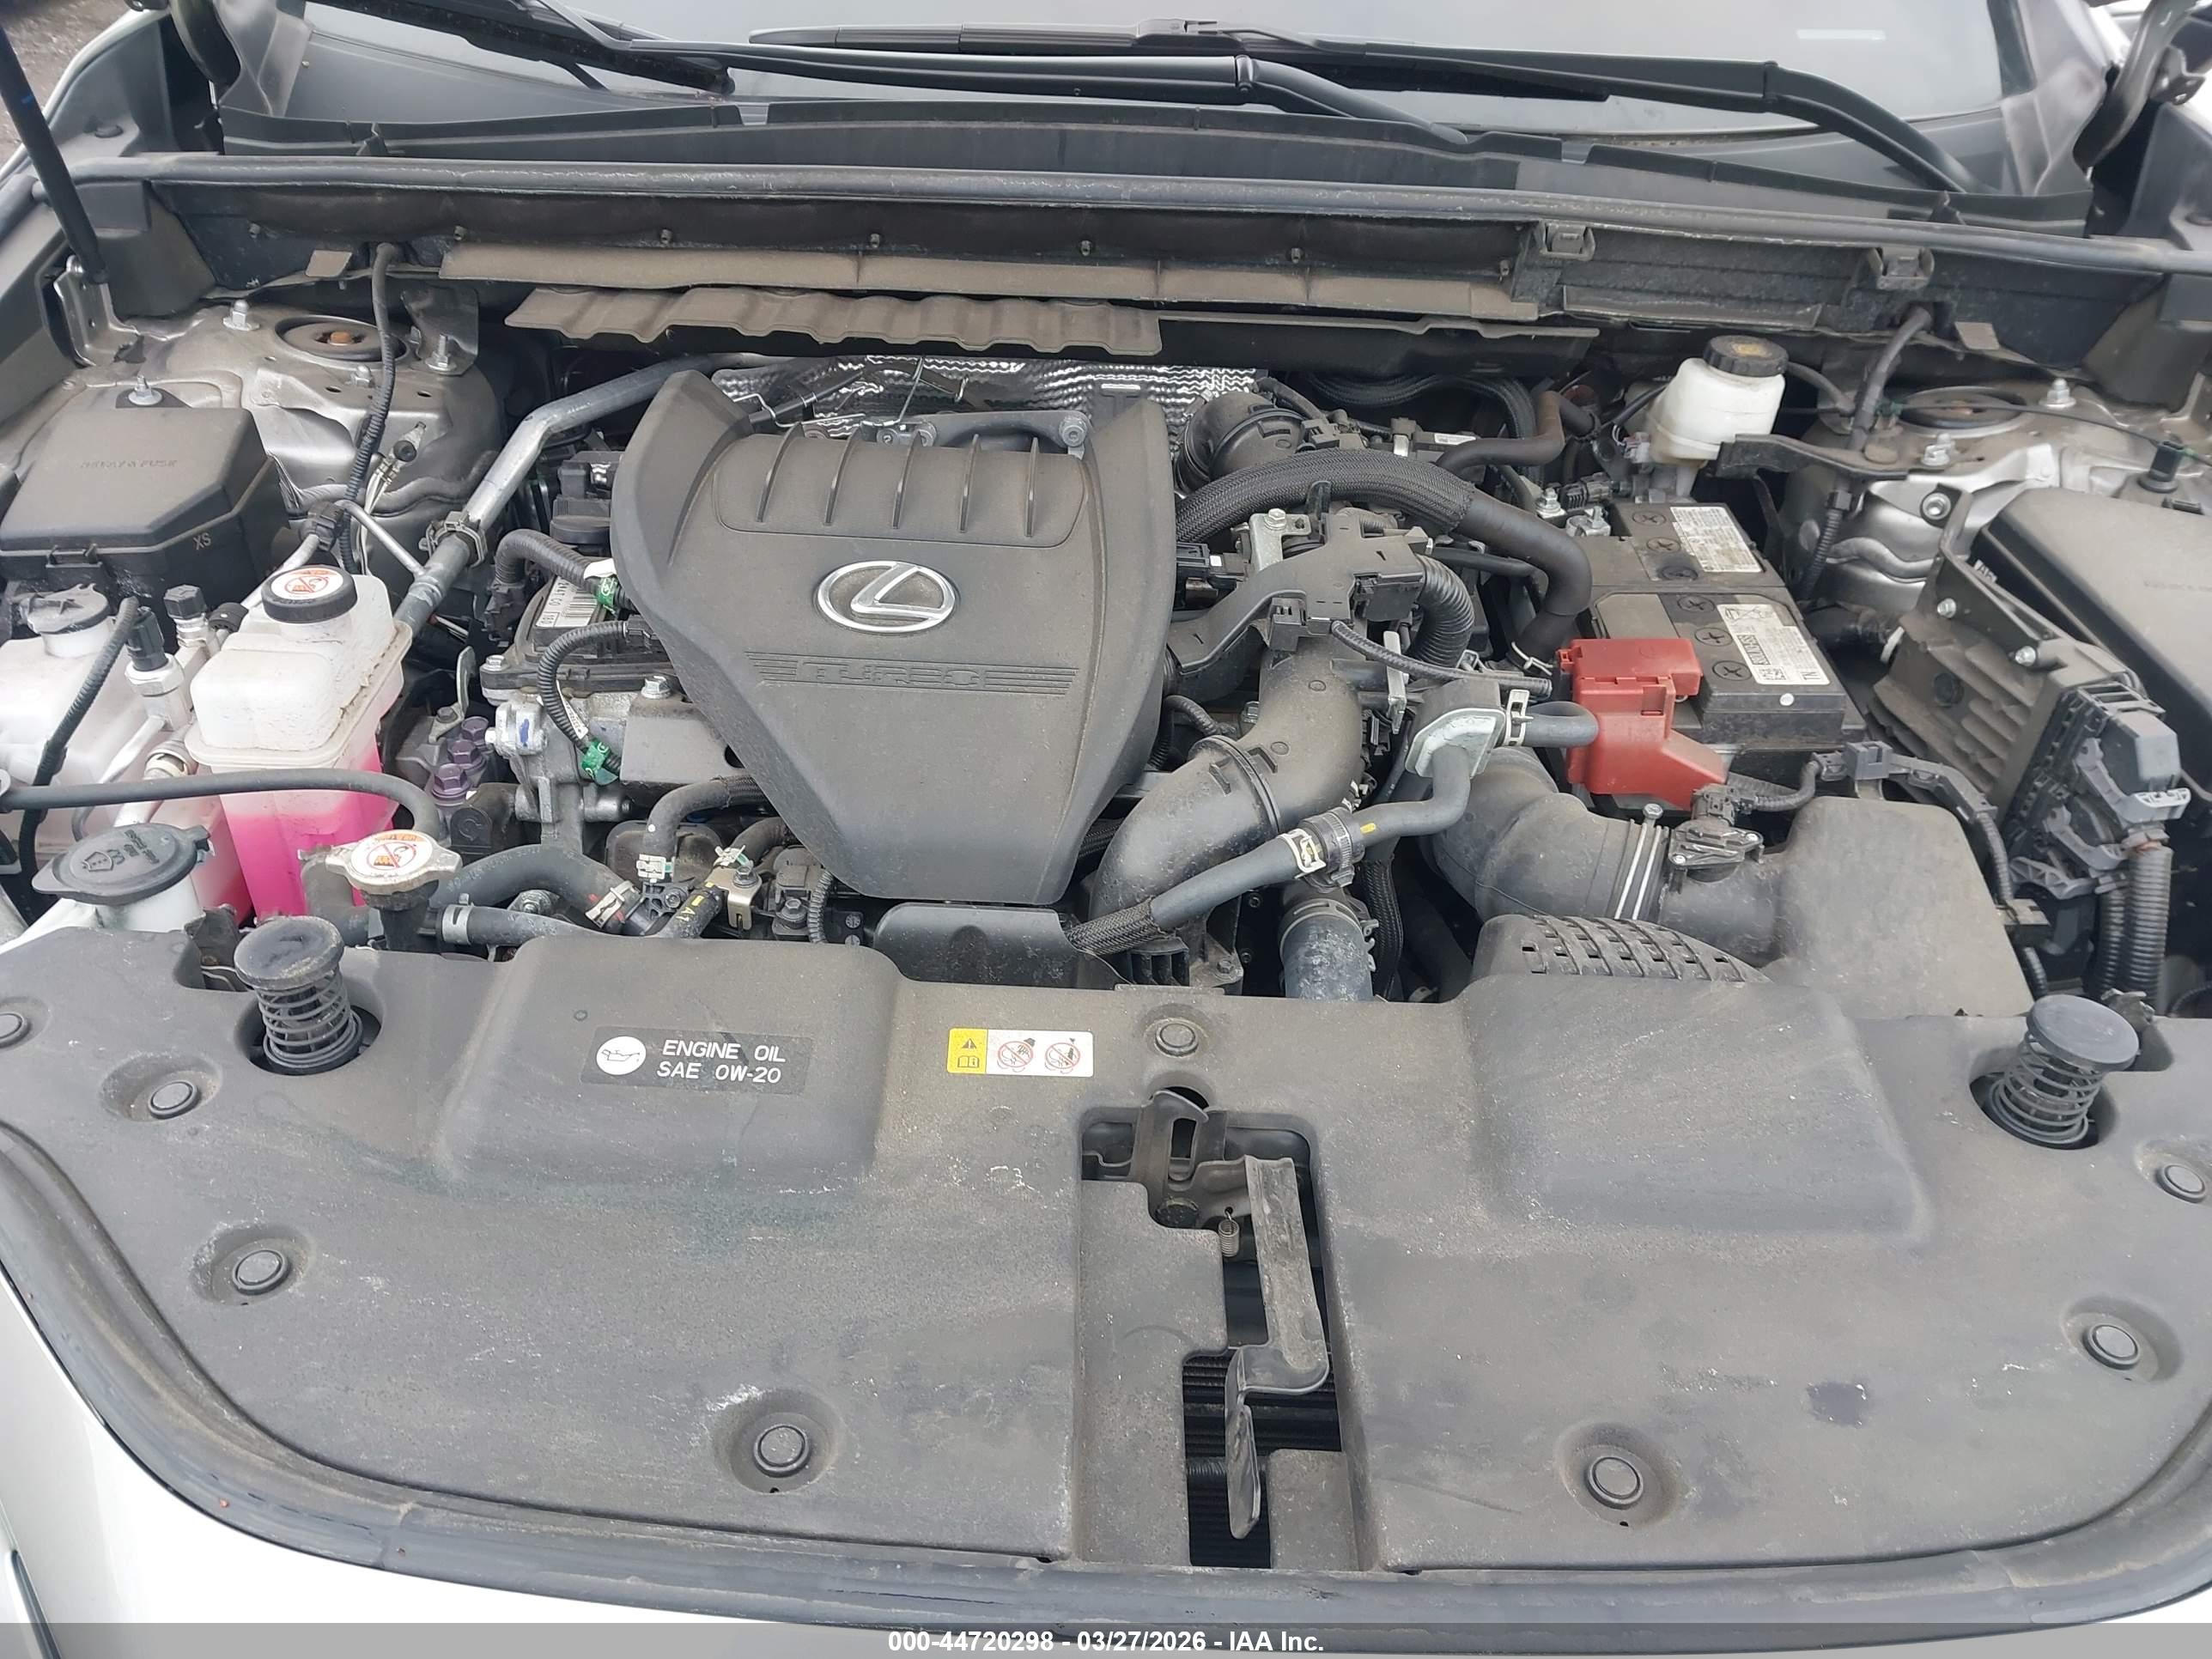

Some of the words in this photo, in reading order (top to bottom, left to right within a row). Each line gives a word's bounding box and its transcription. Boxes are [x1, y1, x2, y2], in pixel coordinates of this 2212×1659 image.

[192, 532, 211, 550] XS
[802, 661, 981, 686] TURBO
[662, 1039, 741, 1060] ENGINE
[754, 1045, 786, 1062] OIL
[656, 1060, 702, 1079] SAE
[715, 1064, 781, 1084] 0W-20
